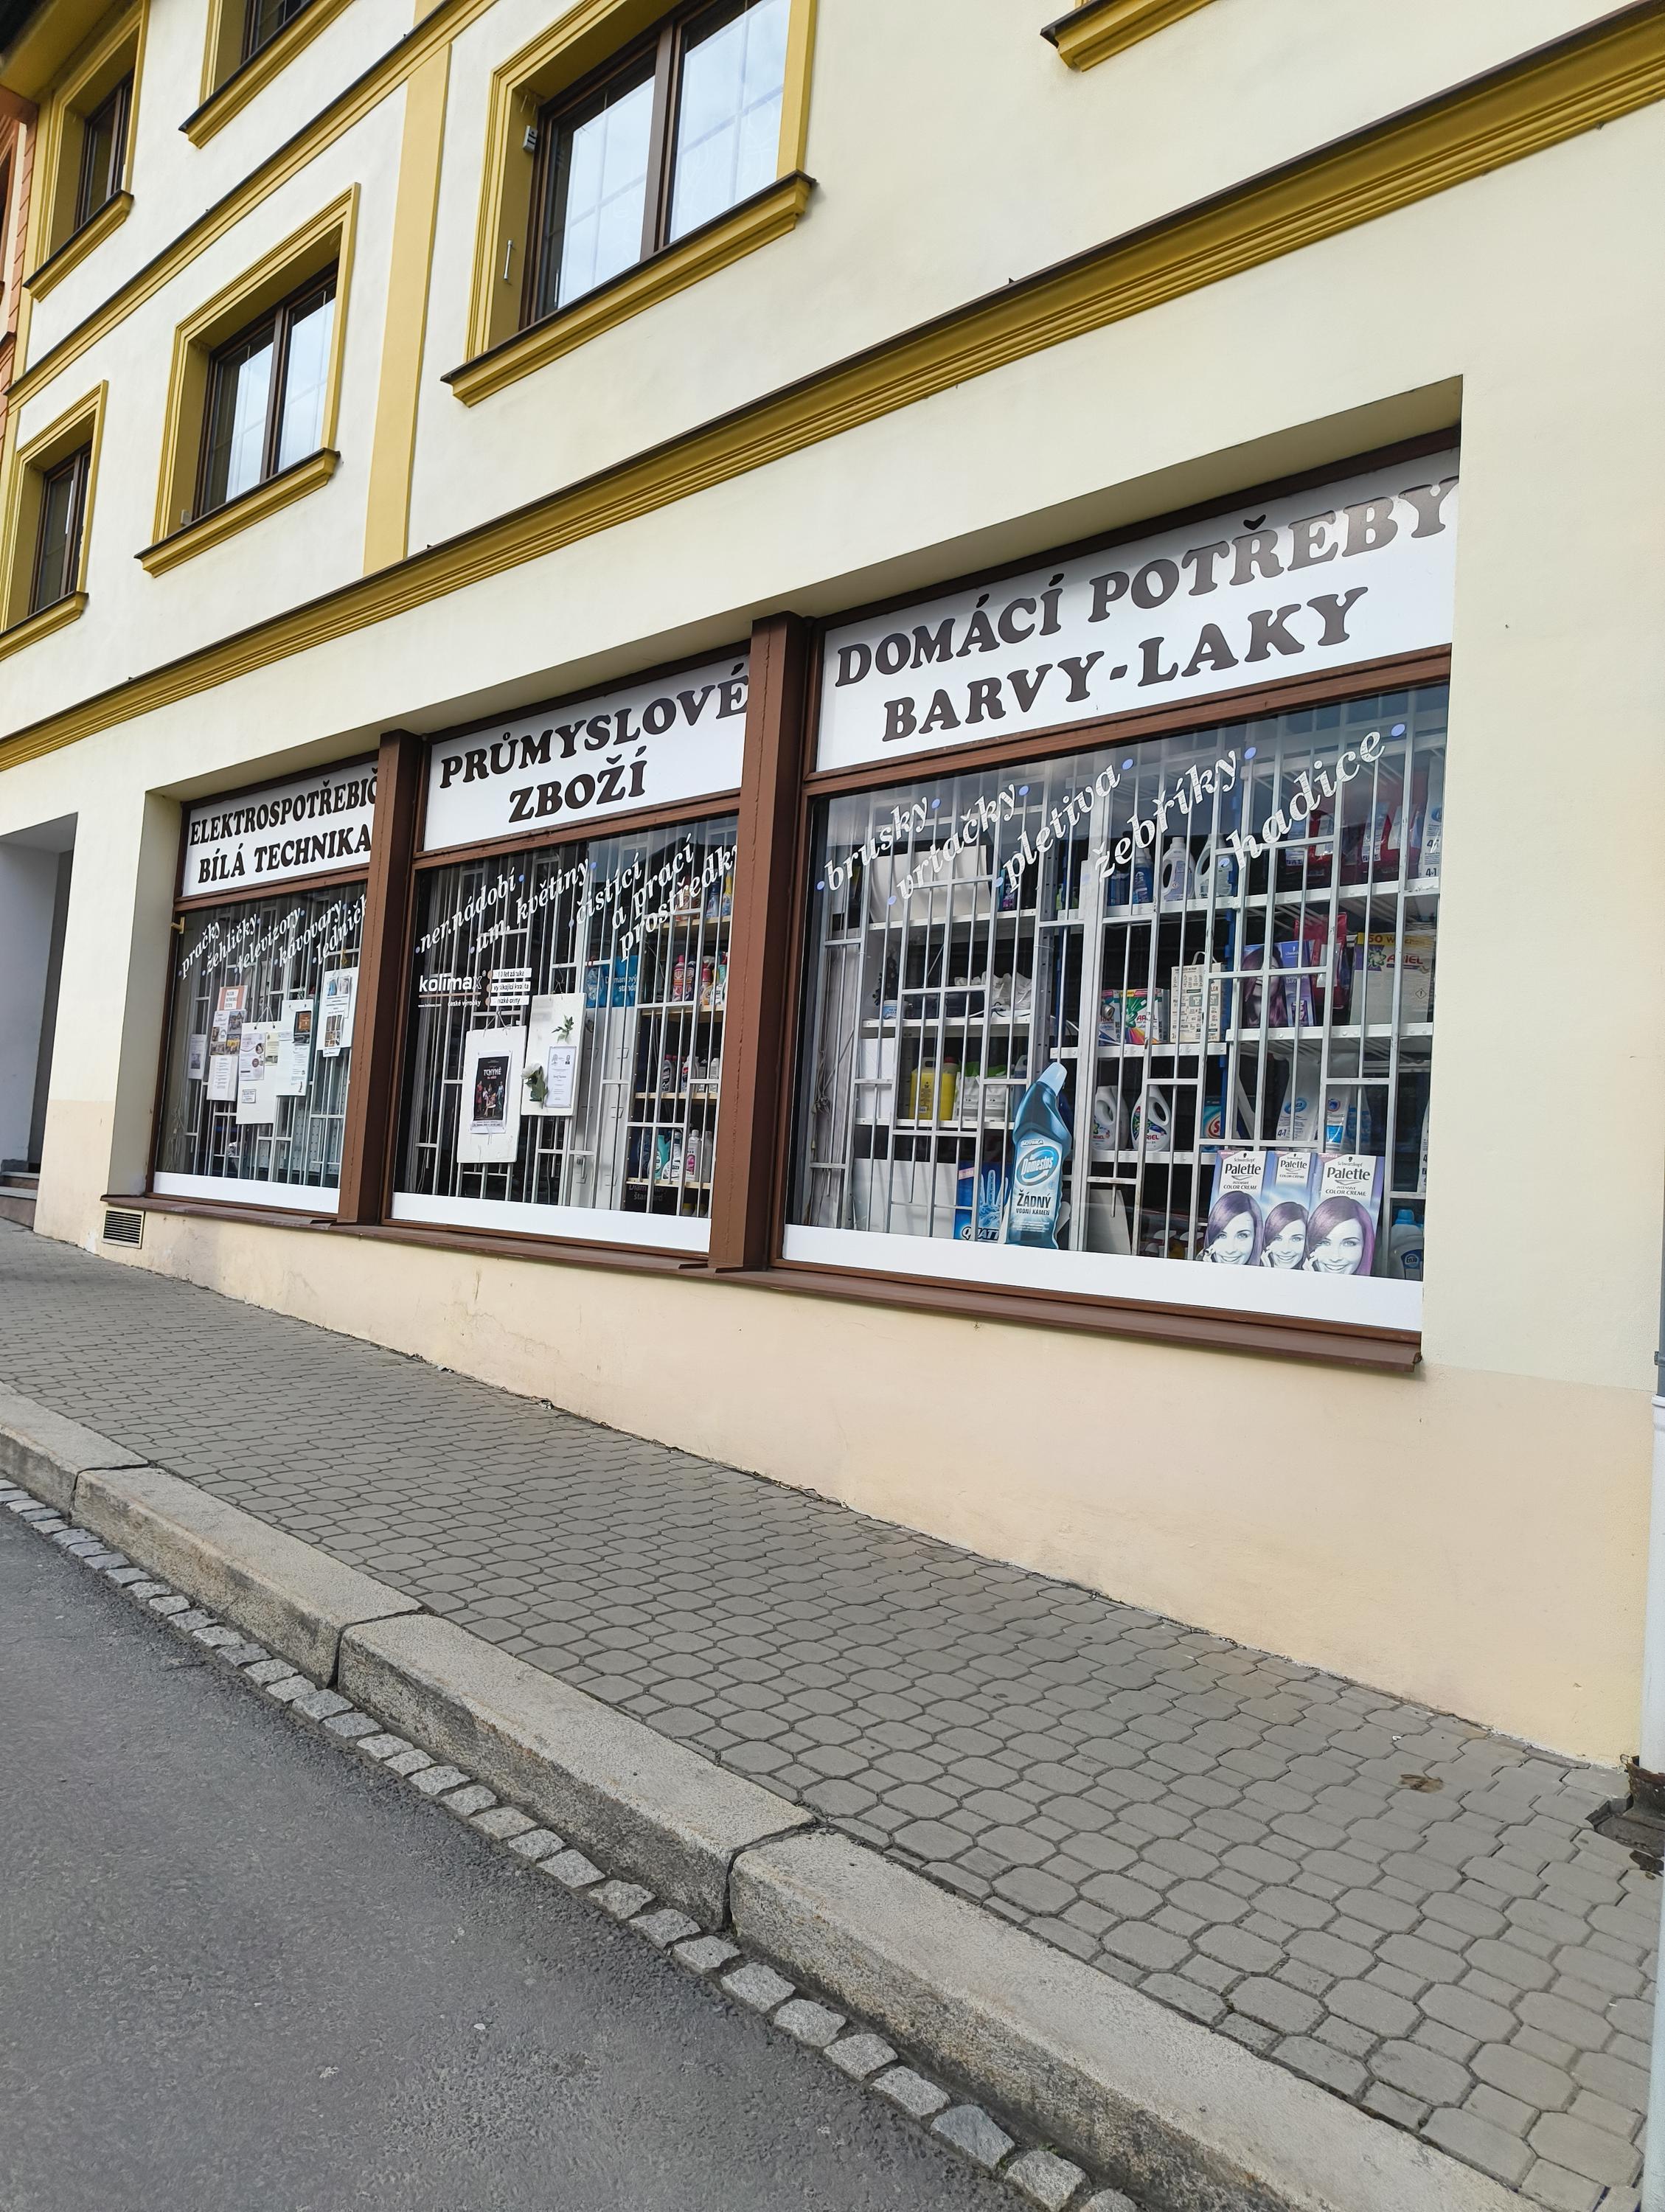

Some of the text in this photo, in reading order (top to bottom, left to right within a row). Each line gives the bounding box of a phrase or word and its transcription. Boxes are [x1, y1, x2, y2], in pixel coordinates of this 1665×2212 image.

[835, 476, 1459, 688] DOMÁCÍ POTŘEBY
[883, 586, 1369, 742] BARVY-LAKY
[439, 663, 749, 789] PRŮMYSLOVÉ
[509, 745, 647, 823] ZBOŽÍ
[1092, 750, 1237, 883] žebříky
[1226, 731, 1385, 872] hadice
[198, 824, 371, 883] BÍLÁ TECHNIKA
[824, 797, 928, 891] brusky
[897, 784, 1015, 900] vrtačky
[1002, 765, 1121, 893] pletiva
[476, 858, 588, 953] um. květiny
[576, 852, 642, 925] čistící
[612, 833, 694, 929] a prací
[181, 922, 220, 980] pračky
[206, 914, 257, 975] žehličky
[237, 908, 300, 975] televizory
[279, 900, 341, 967] kávovary
[1387, 954, 1423, 964] AIEL
[1017, 1189, 1052, 1208] ŽÁDNÝ
[1021, 1156, 1054, 1175] Domestos
[1225, 1164, 1261, 1175] Palette
[1281, 1160, 1307, 1169] Palette
[1327, 1167, 1370, 1180] Palette
